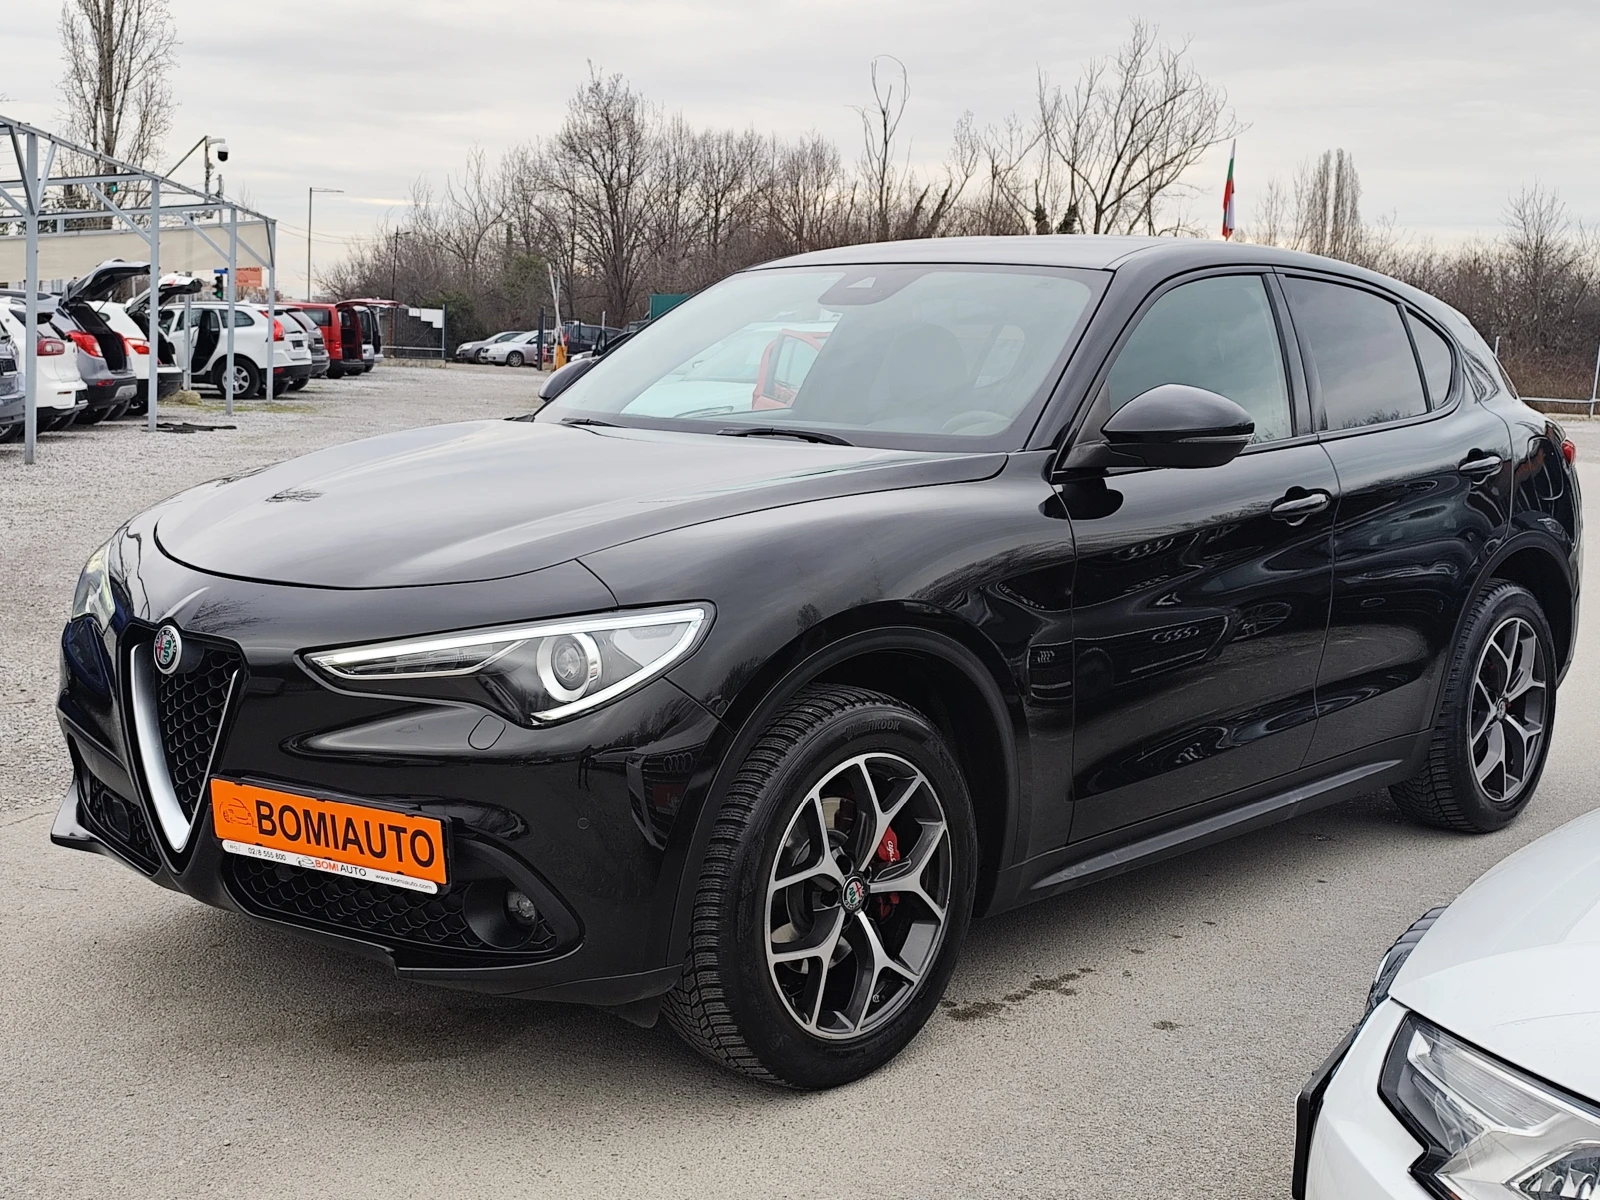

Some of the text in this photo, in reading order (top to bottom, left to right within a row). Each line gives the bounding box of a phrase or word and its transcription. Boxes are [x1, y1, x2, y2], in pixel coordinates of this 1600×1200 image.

[255, 799, 435, 868] BOMIAUTO
[248, 848, 287, 862] 02/8 555 800
[315, 859, 367, 877] BOMI AUTO
[375, 874, 433, 890] www.bomiauto.com
